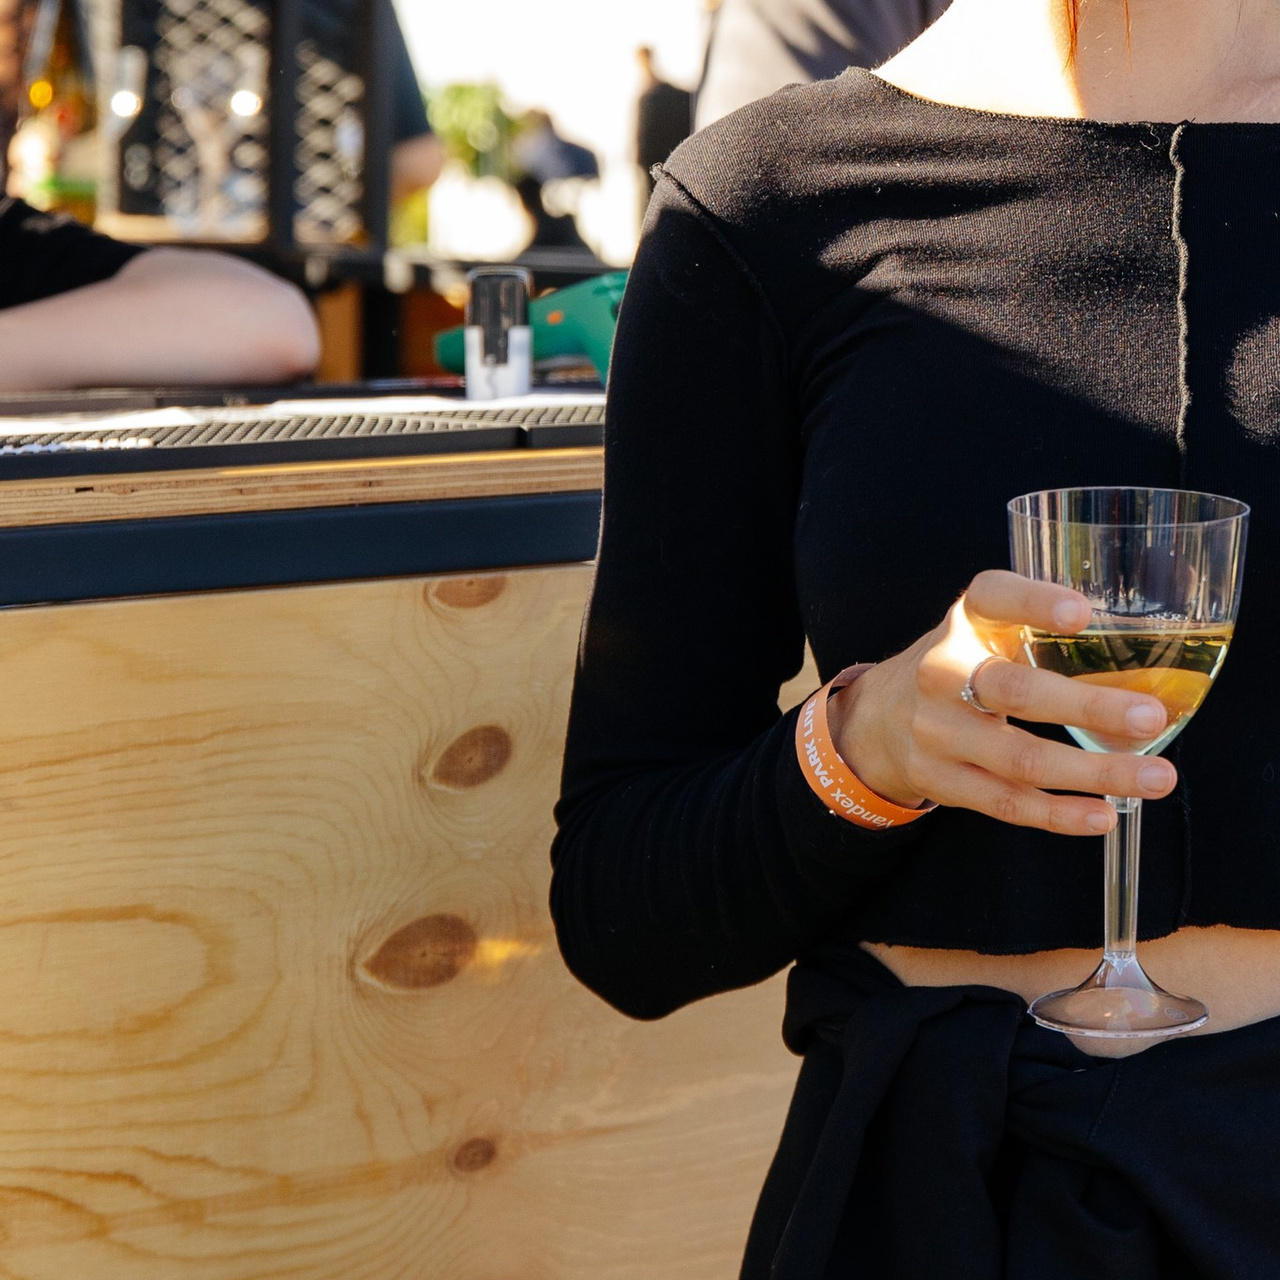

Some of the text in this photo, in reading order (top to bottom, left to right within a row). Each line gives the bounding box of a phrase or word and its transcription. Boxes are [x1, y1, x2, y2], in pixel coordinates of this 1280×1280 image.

[803, 698, 894, 828] Yandex PARK LIVE
